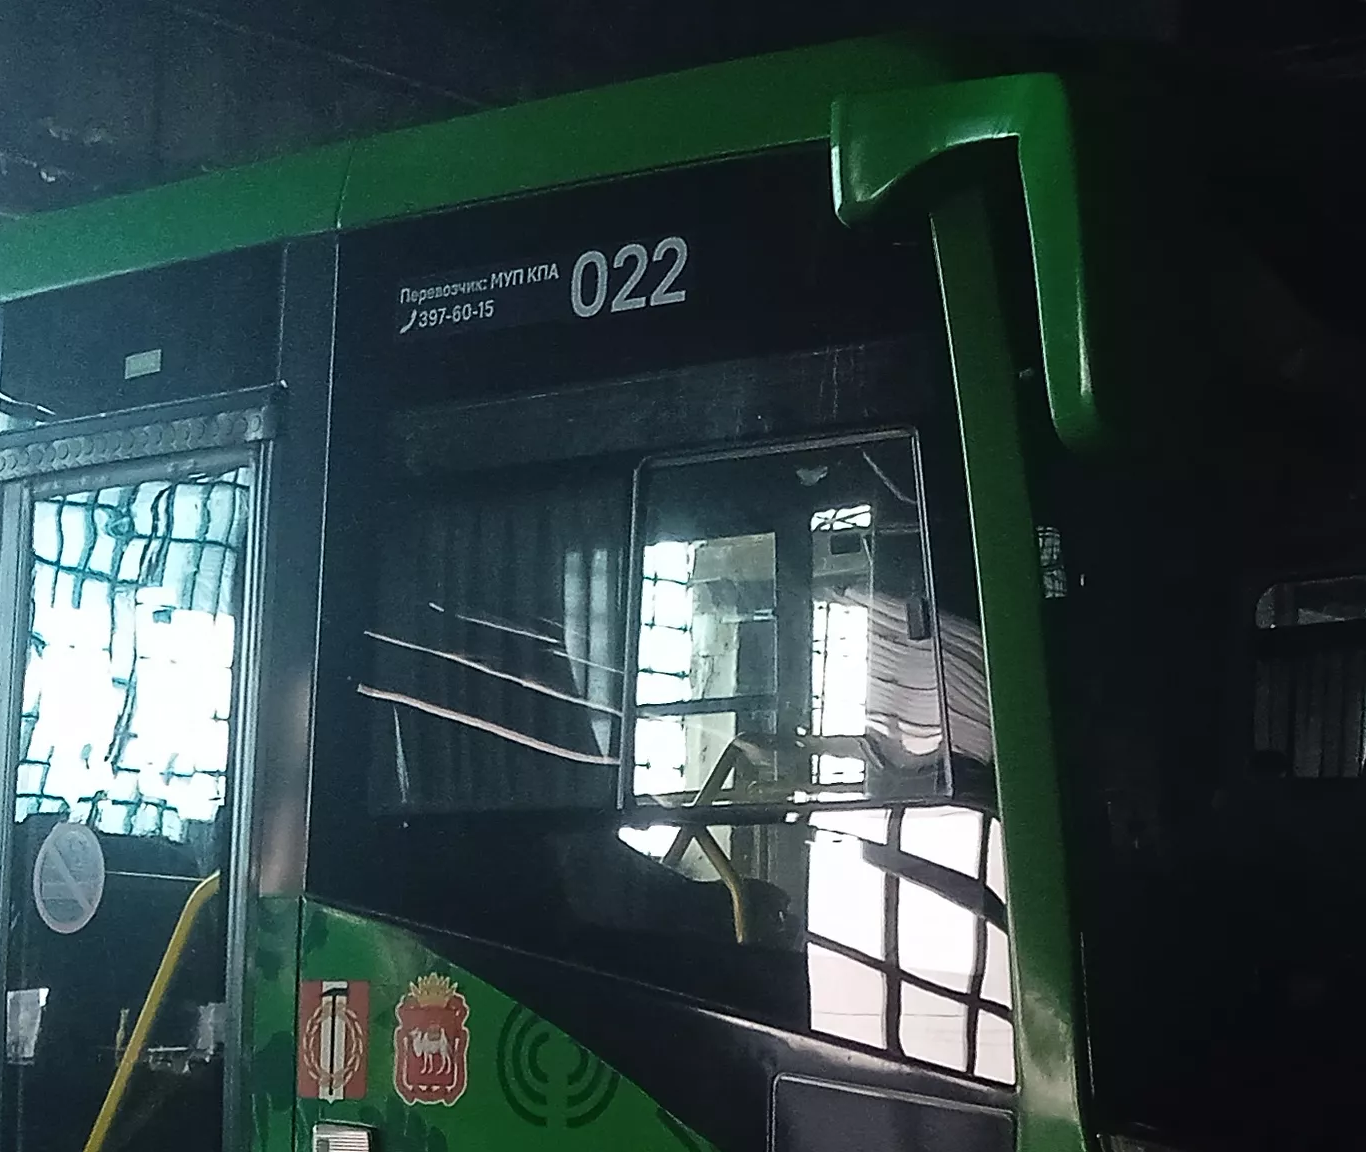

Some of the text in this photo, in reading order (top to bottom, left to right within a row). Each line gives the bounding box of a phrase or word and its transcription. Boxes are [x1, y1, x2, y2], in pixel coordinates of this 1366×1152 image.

[400, 262, 560, 305] Перевозчик: МУП КПА
[571, 236, 689, 318] 022
[418, 299, 496, 328] 397-60-15
